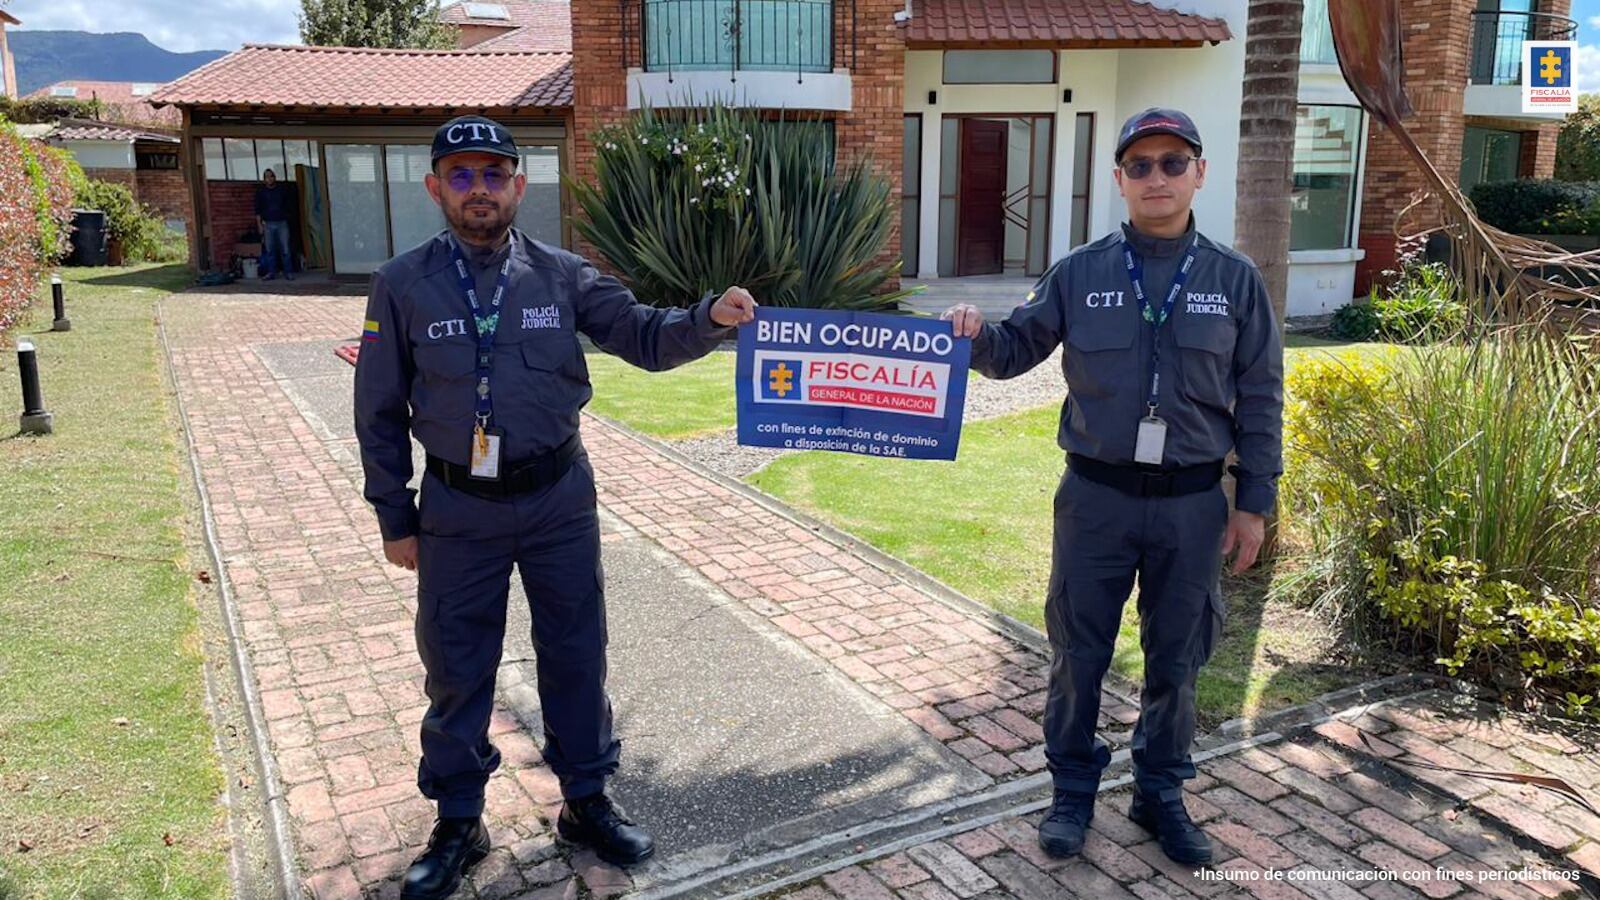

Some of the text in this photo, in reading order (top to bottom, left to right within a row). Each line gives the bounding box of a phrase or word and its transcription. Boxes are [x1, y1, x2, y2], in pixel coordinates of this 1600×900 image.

[446, 123, 501, 144] CTI
[1086, 291, 1124, 308] CTI
[1186, 292, 1229, 305] POLICÍA
[521, 303, 560, 318] POLICÍA
[1185, 303, 1229, 316] JUDICIAL
[427, 319, 467, 340] CTI
[520, 317, 561, 329] JUDICIAL
[757, 320, 953, 356] BIEN OCUPADO
[809, 361, 937, 390] FISCALÍA
[811, 388, 933, 411] GENERAL DE LA NACIÓN
[757, 423, 779, 433] con
[781, 422, 807, 435] fines
[808, 424, 823, 435] de
[873, 431, 889, 442] de
[891, 433, 938, 448] dominio
[784, 438, 907, 457] a disposición de la SAE.
